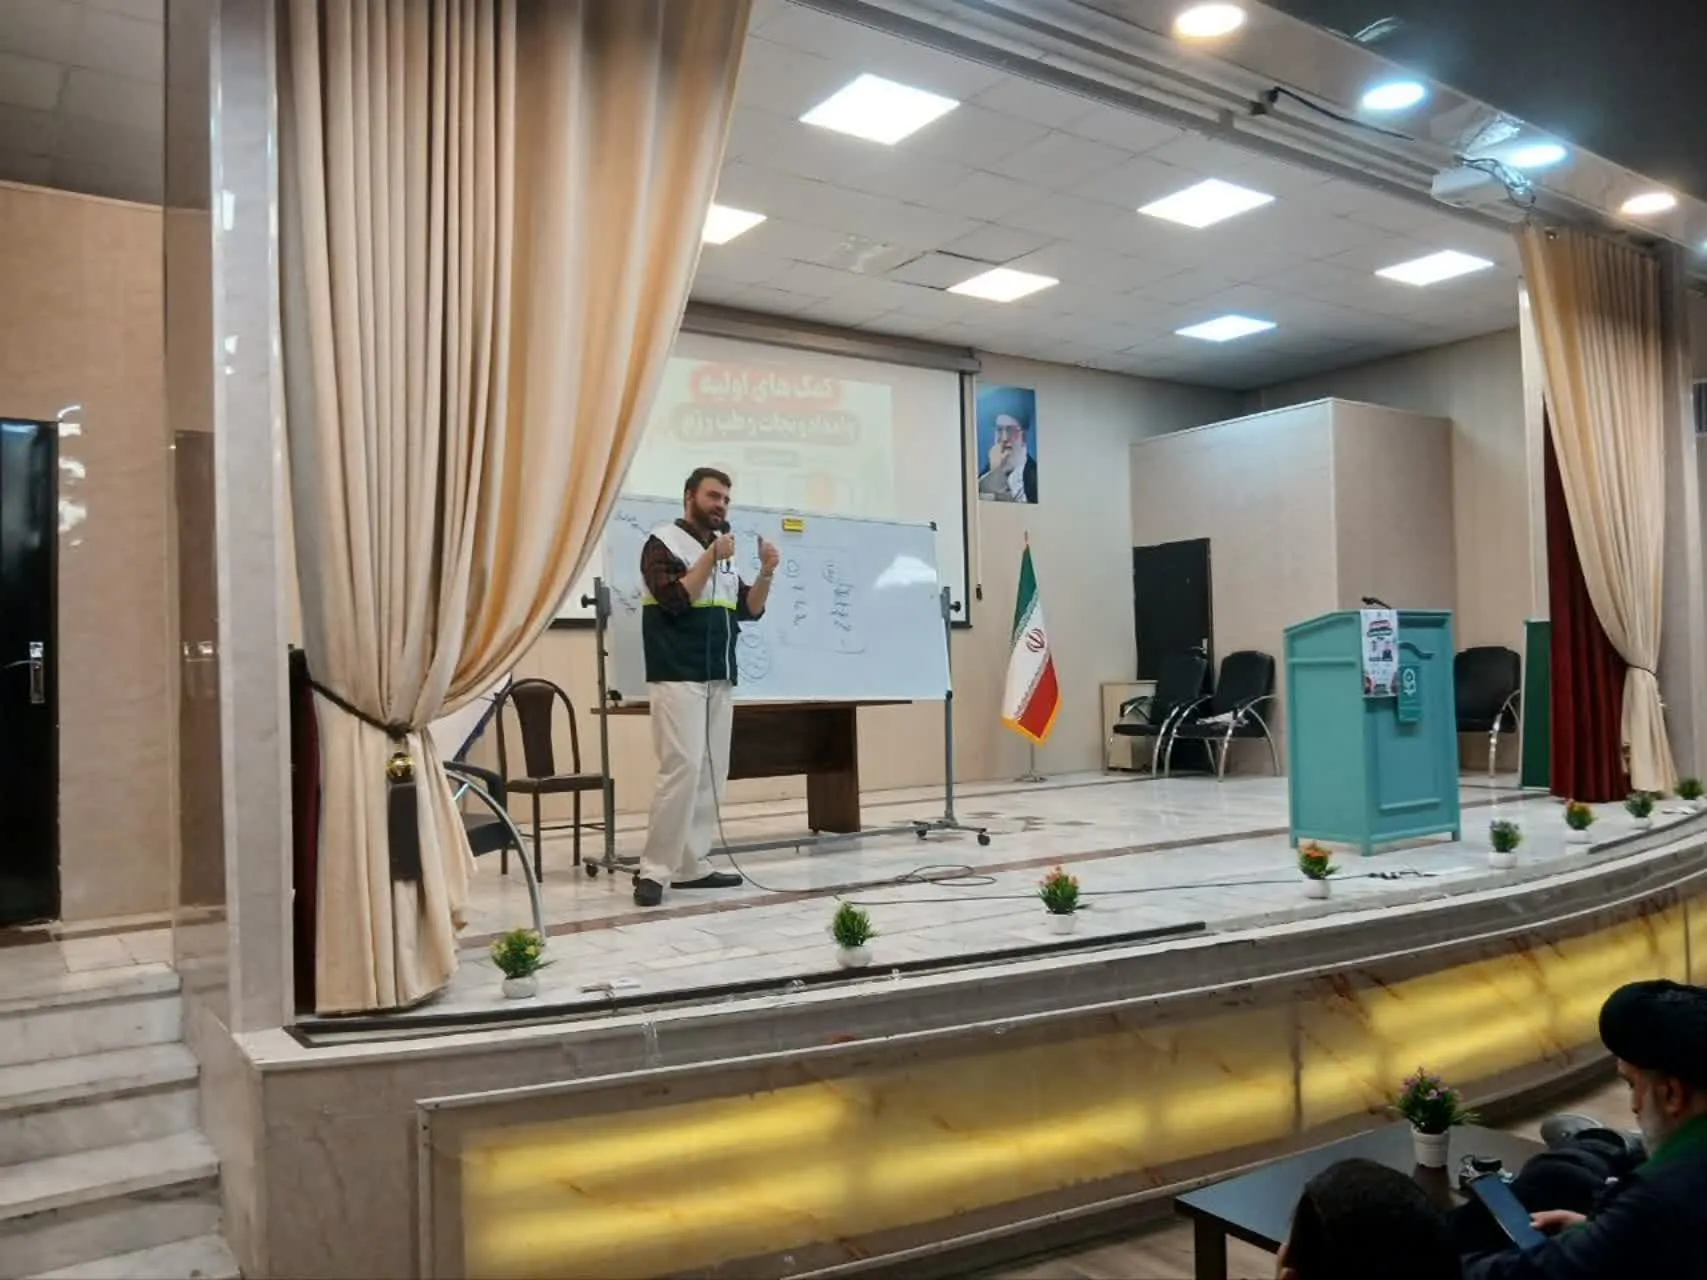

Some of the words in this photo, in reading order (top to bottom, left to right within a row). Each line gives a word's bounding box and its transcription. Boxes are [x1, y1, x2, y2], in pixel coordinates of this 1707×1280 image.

[699, 371, 749, 402] اولیه
[752, 372, 791, 404] های
[794, 374, 834, 399] کمک
